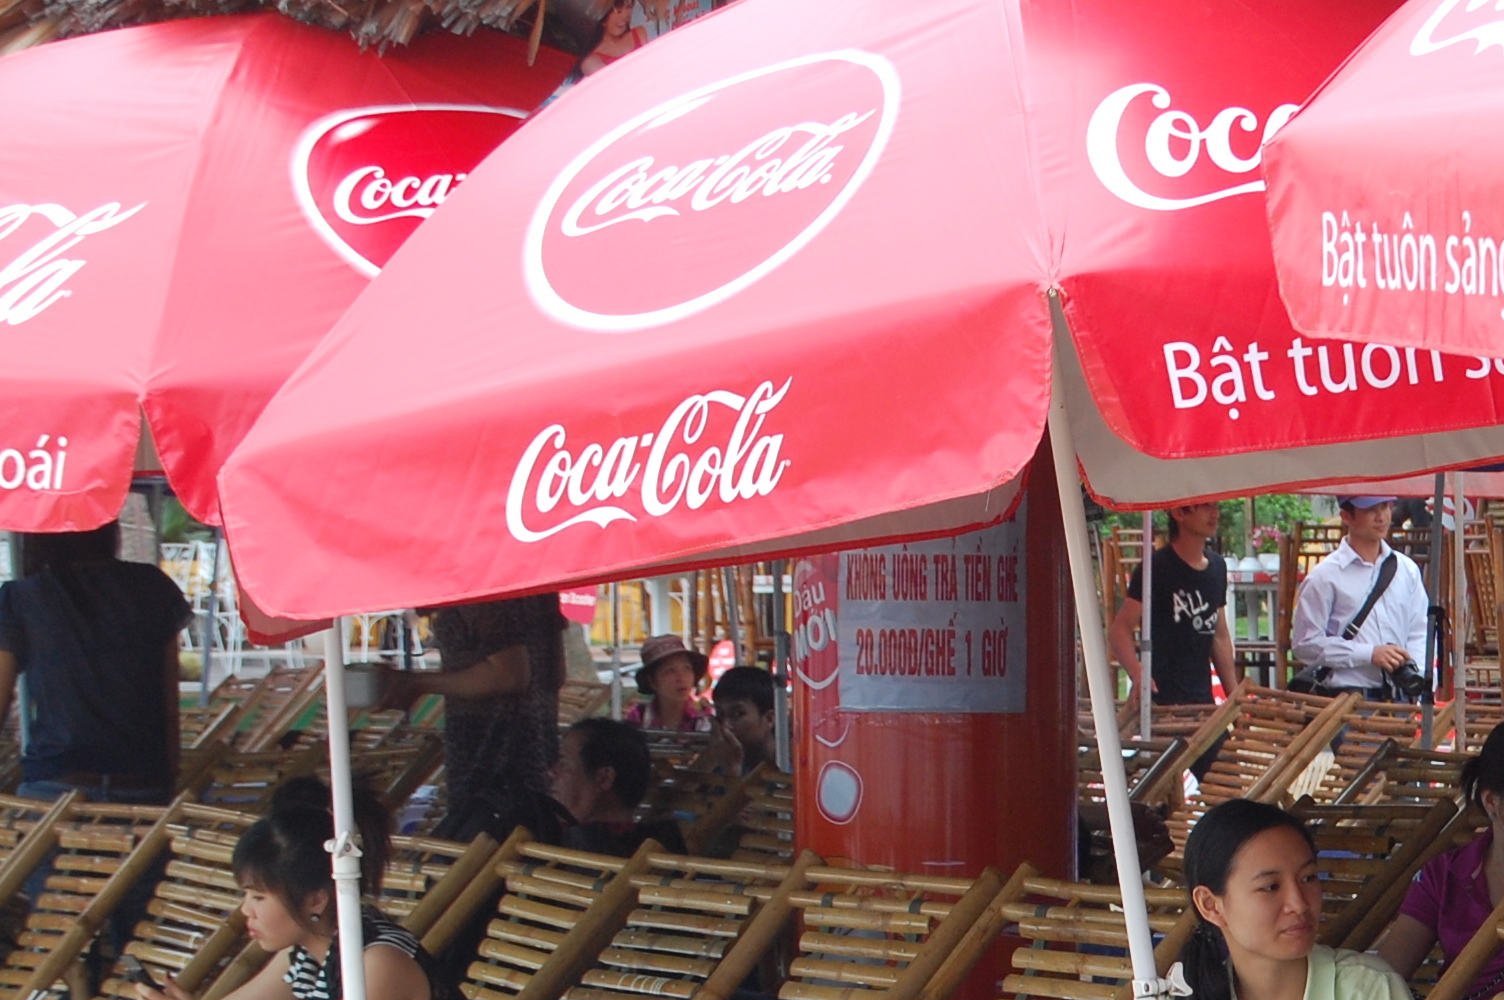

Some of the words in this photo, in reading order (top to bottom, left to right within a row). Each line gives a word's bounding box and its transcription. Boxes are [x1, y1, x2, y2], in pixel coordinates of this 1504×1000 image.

[561, 108, 877, 236] Coca-Cola
[1322, 210, 1366, 306] Bật
[1372, 212, 1437, 291] tuôn
[1162, 336, 1275, 420] Bật
[505, 376, 792, 542] Coca-Cola
[964, 536, 991, 601] TIỀN
[856, 612, 957, 677] 20.000Đ/GHẾ
[965, 629, 972, 677] 1
[982, 616, 1008, 677] GIỜ
